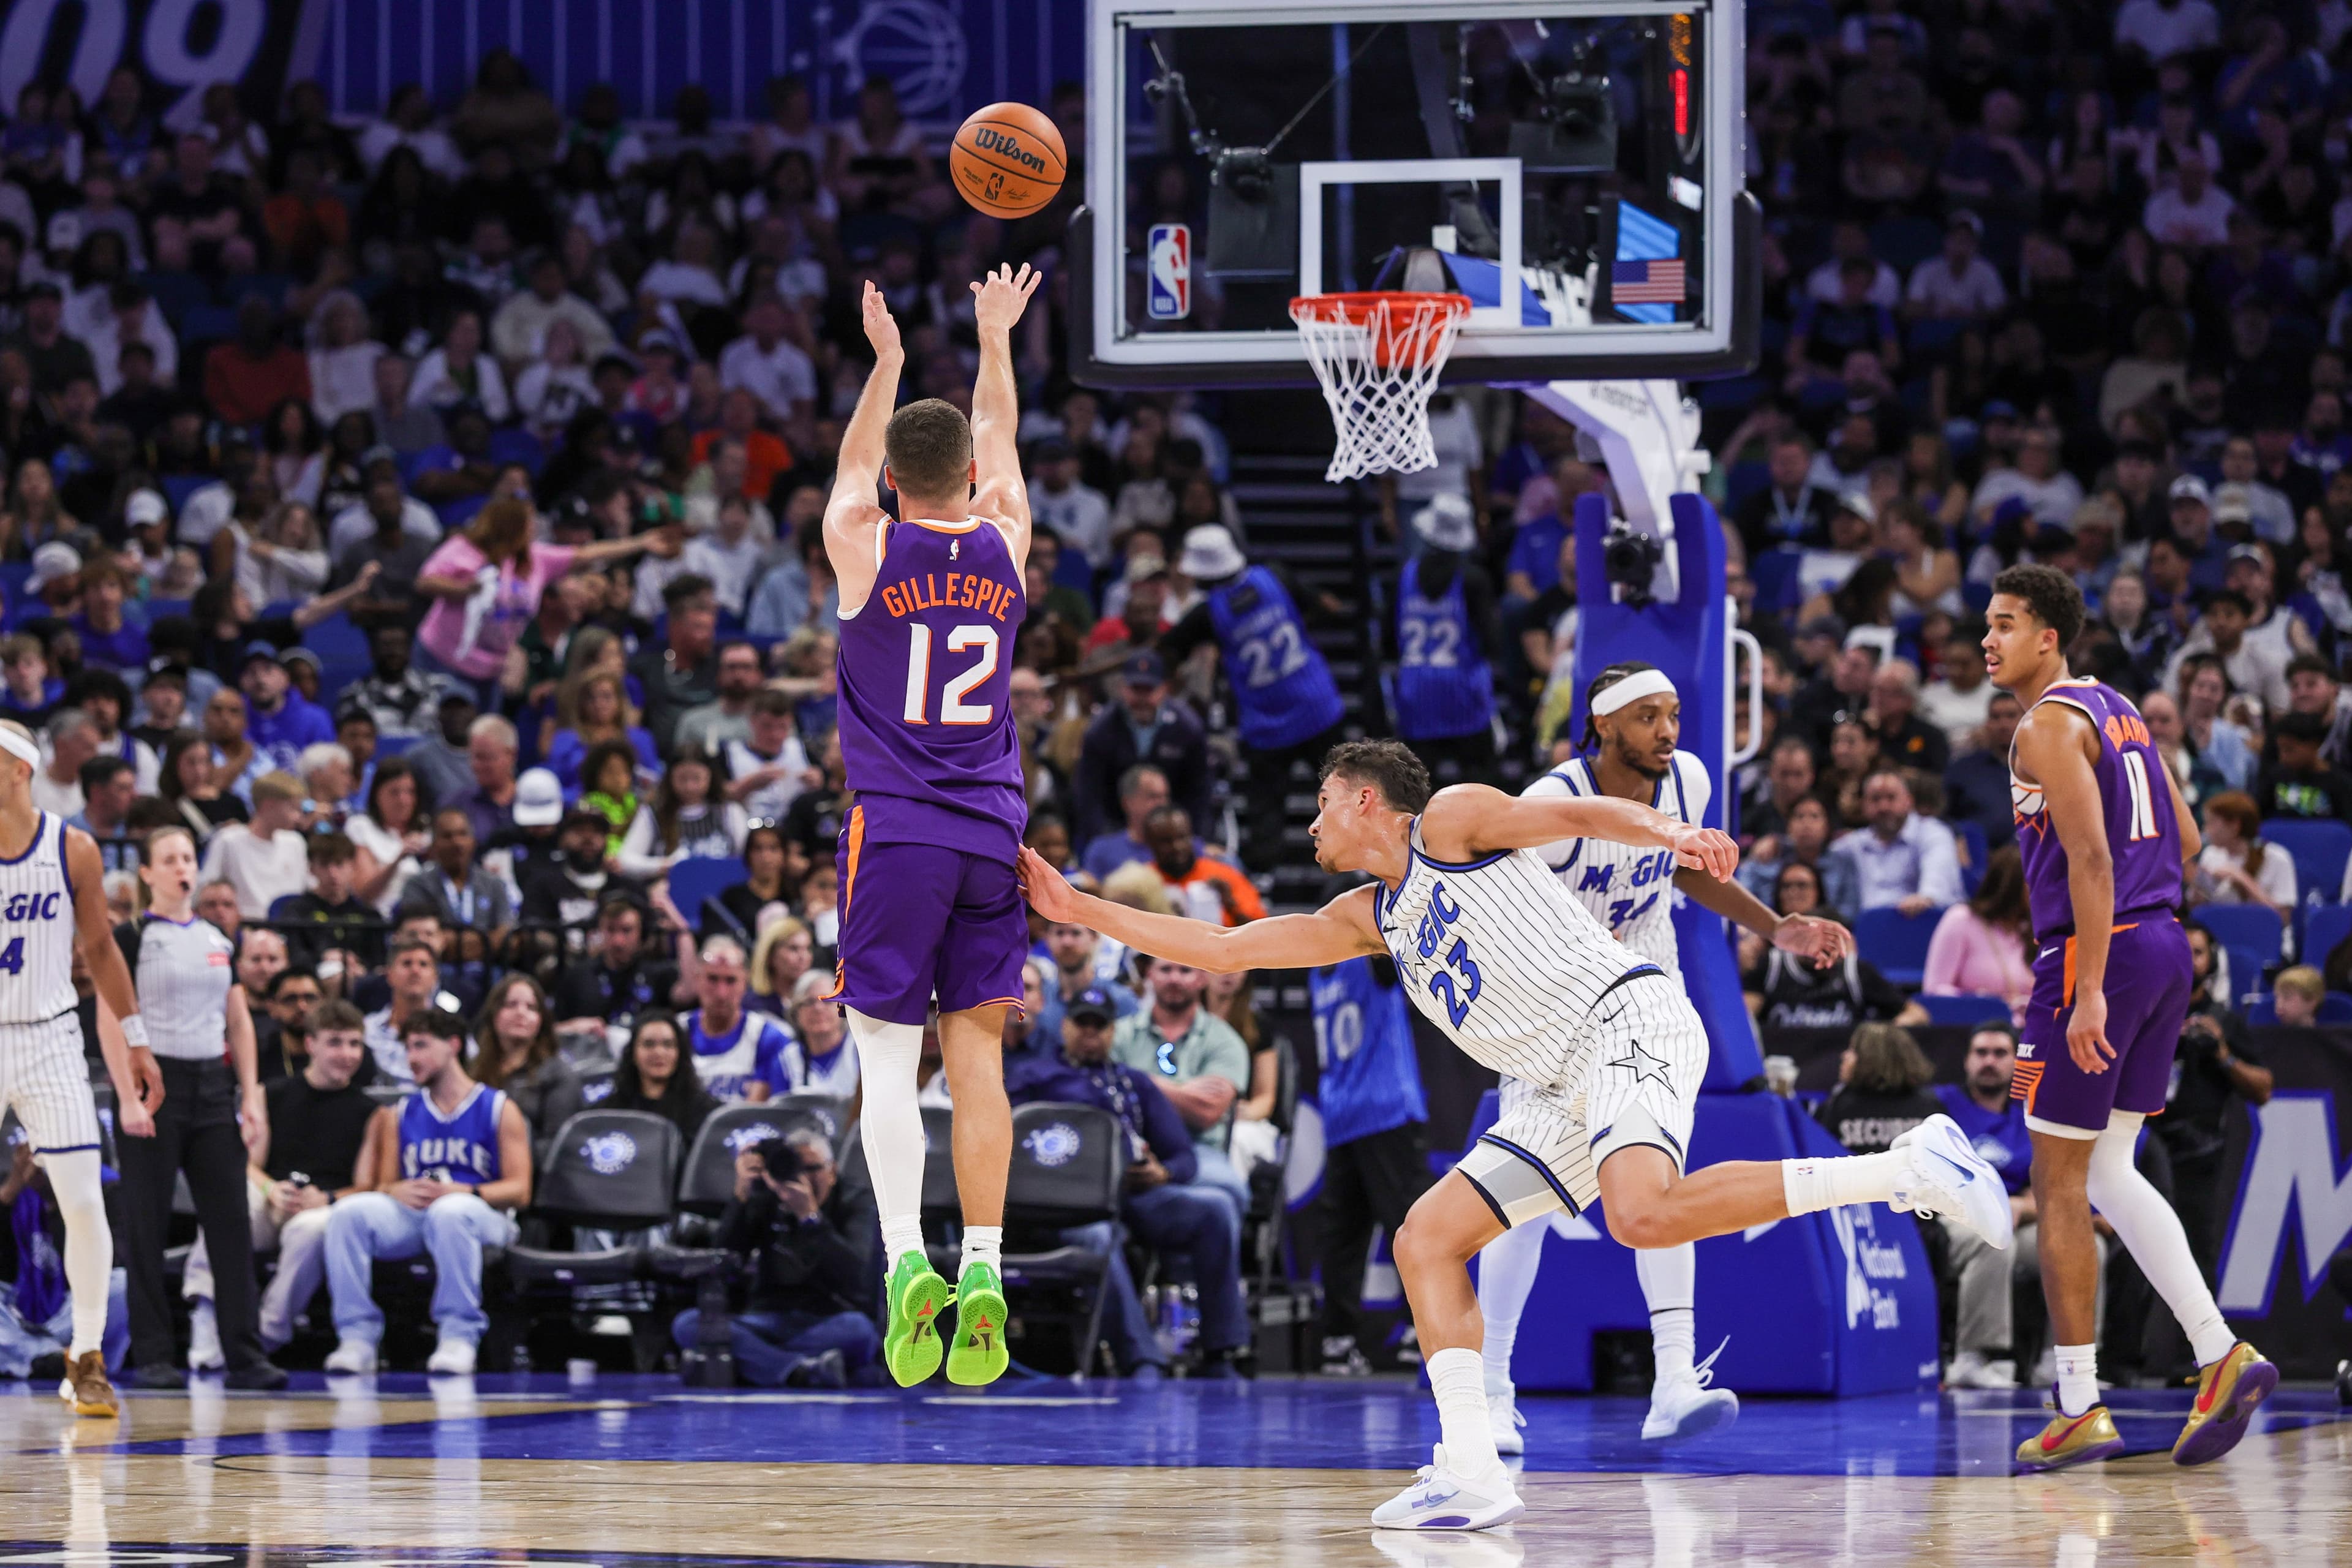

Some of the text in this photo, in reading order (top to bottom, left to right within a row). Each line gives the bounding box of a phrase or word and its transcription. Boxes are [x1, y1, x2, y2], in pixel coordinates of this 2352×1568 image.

[974, 127, 1046, 175] Wilson
[881, 573, 1017, 622] GILLESPIE
[1237, 620, 1309, 688] 22
[1400, 619, 1461, 667] 22
[903, 622, 1000, 725] 12
[2122, 750, 2160, 842] 11
[4, 891, 60, 921] GIC
[0, 937, 24, 976] 4
[1428, 936, 1482, 1031] 23
[1314, 1000, 1364, 1069] 10
